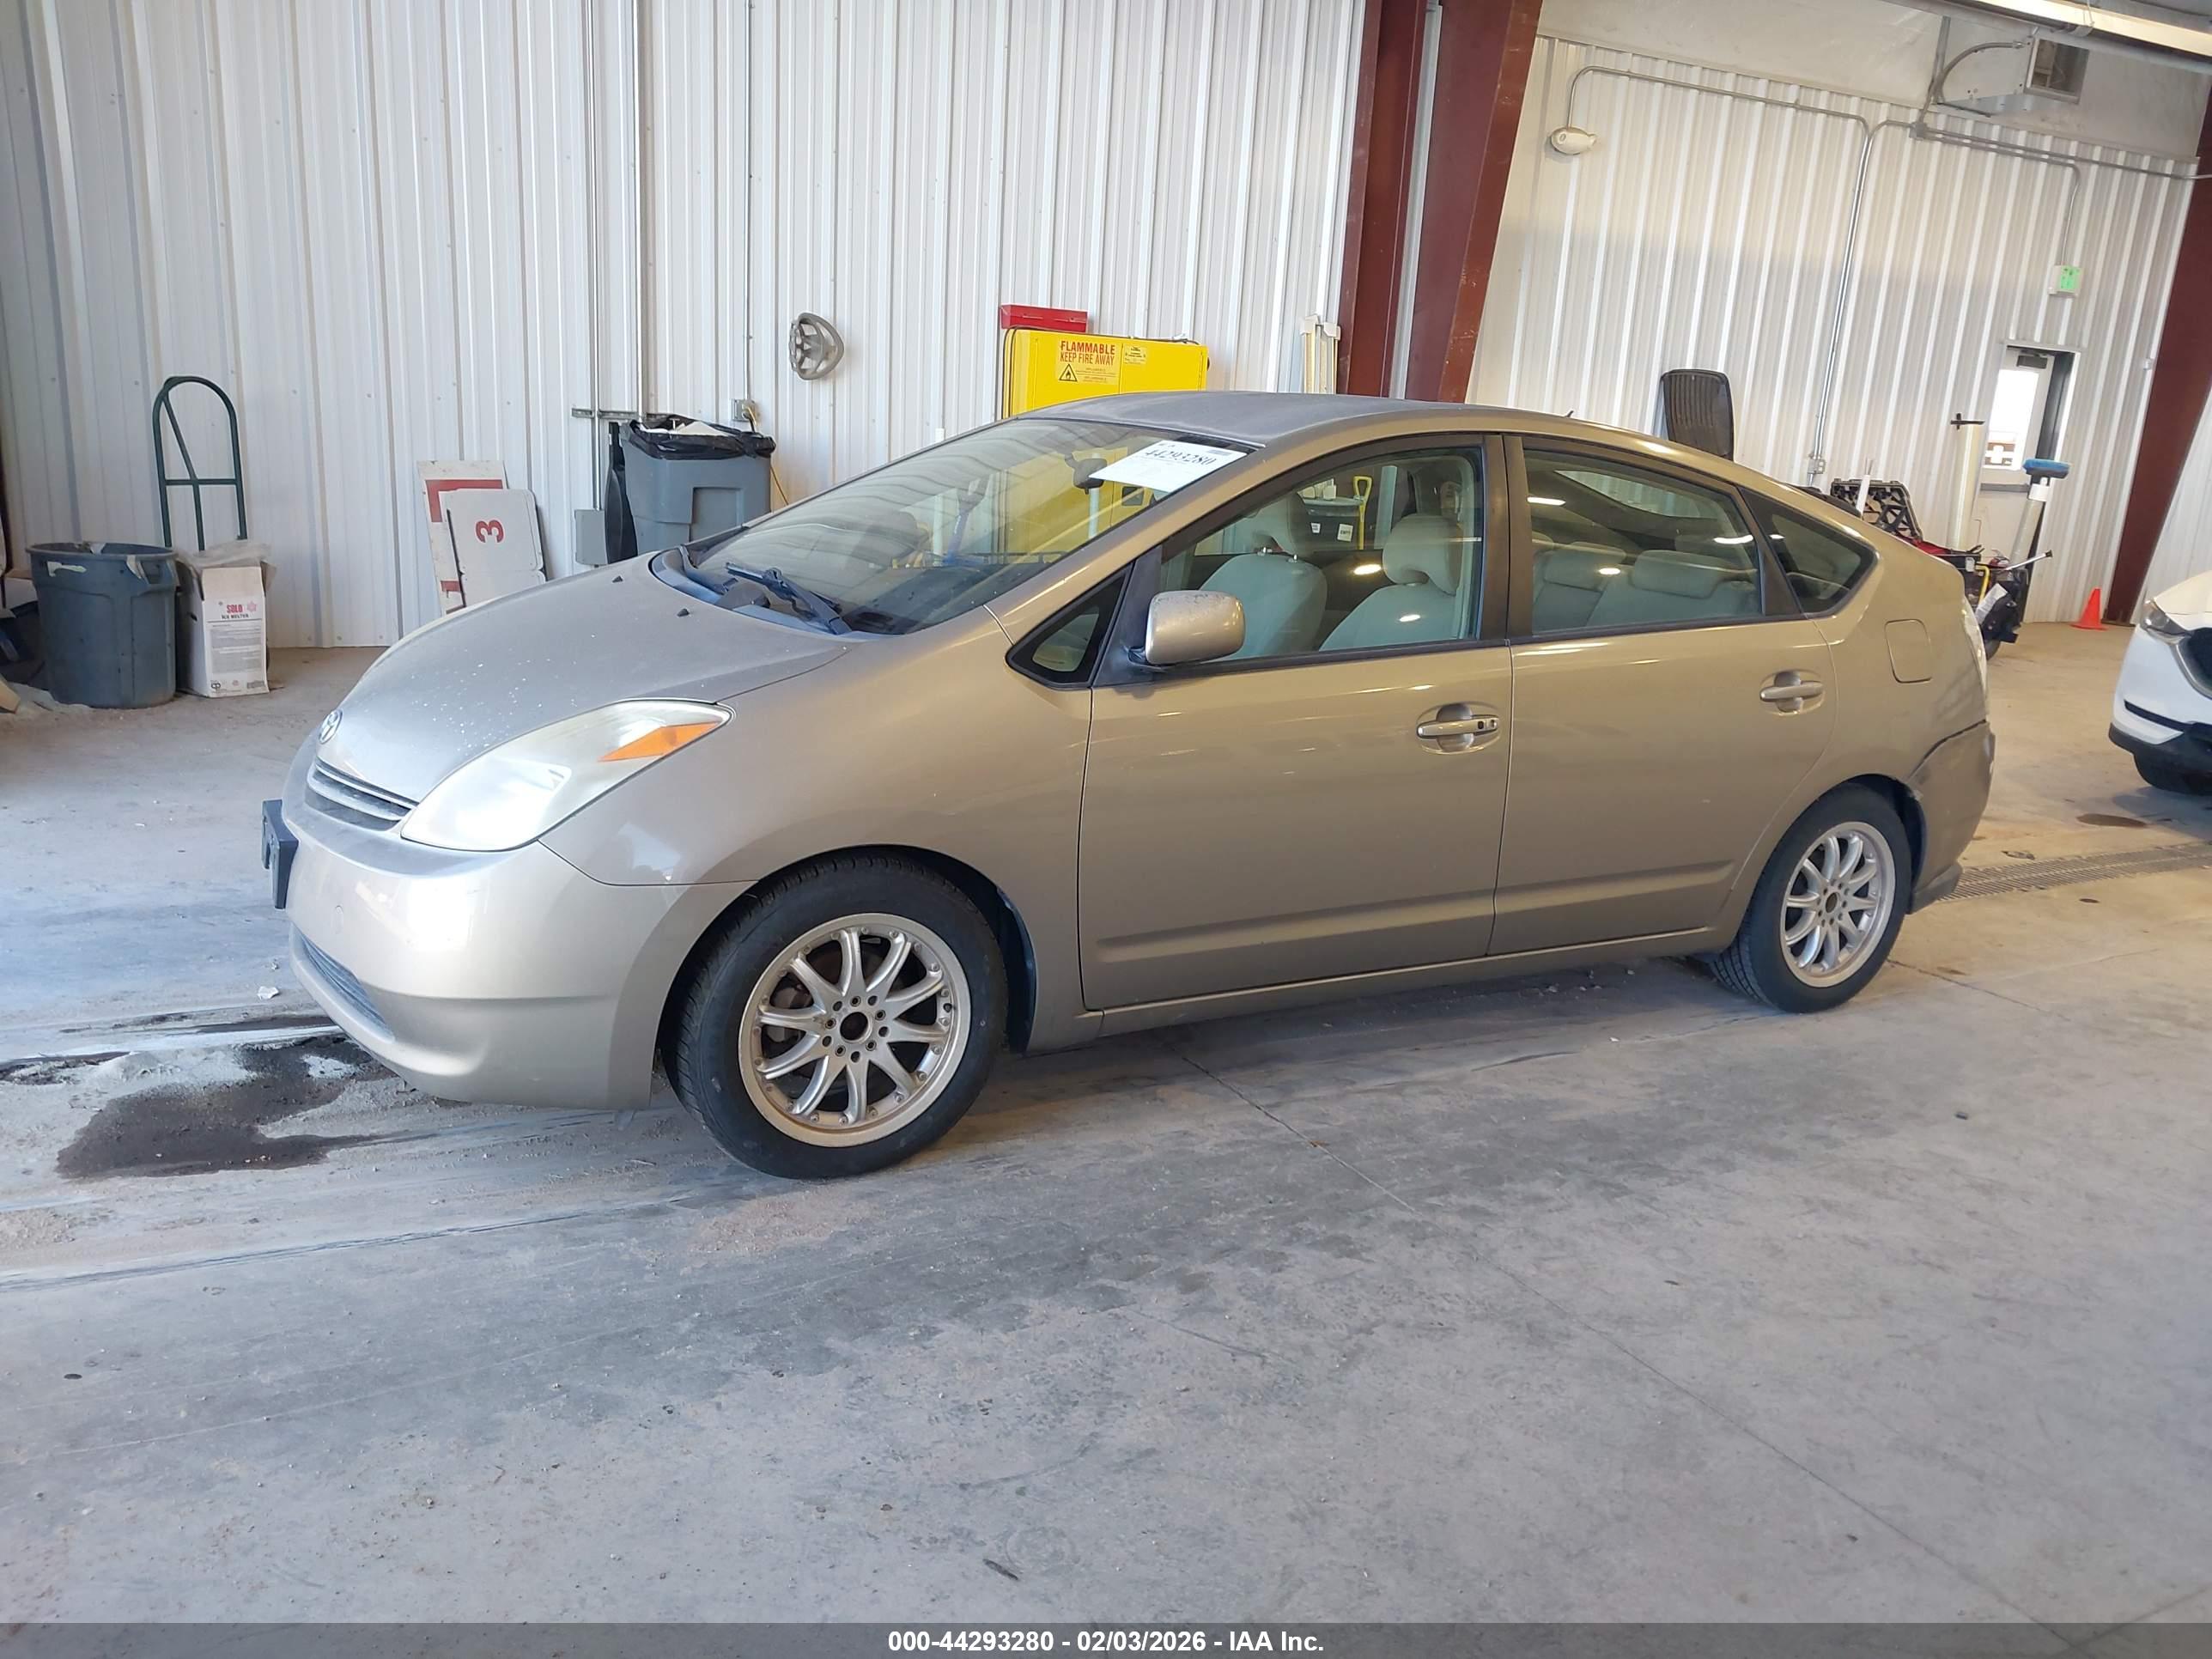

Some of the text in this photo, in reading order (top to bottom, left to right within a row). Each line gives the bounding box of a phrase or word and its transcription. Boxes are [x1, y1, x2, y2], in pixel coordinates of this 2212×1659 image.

[1060, 340, 1115, 355] FLAMMABLE
[1060, 351, 1077, 362] KEEP
[1079, 353, 1093, 364] FIRE
[1095, 355, 1115, 366] AWAY
[475, 520, 504, 543] 3
[226, 604, 243, 613] SOLO
